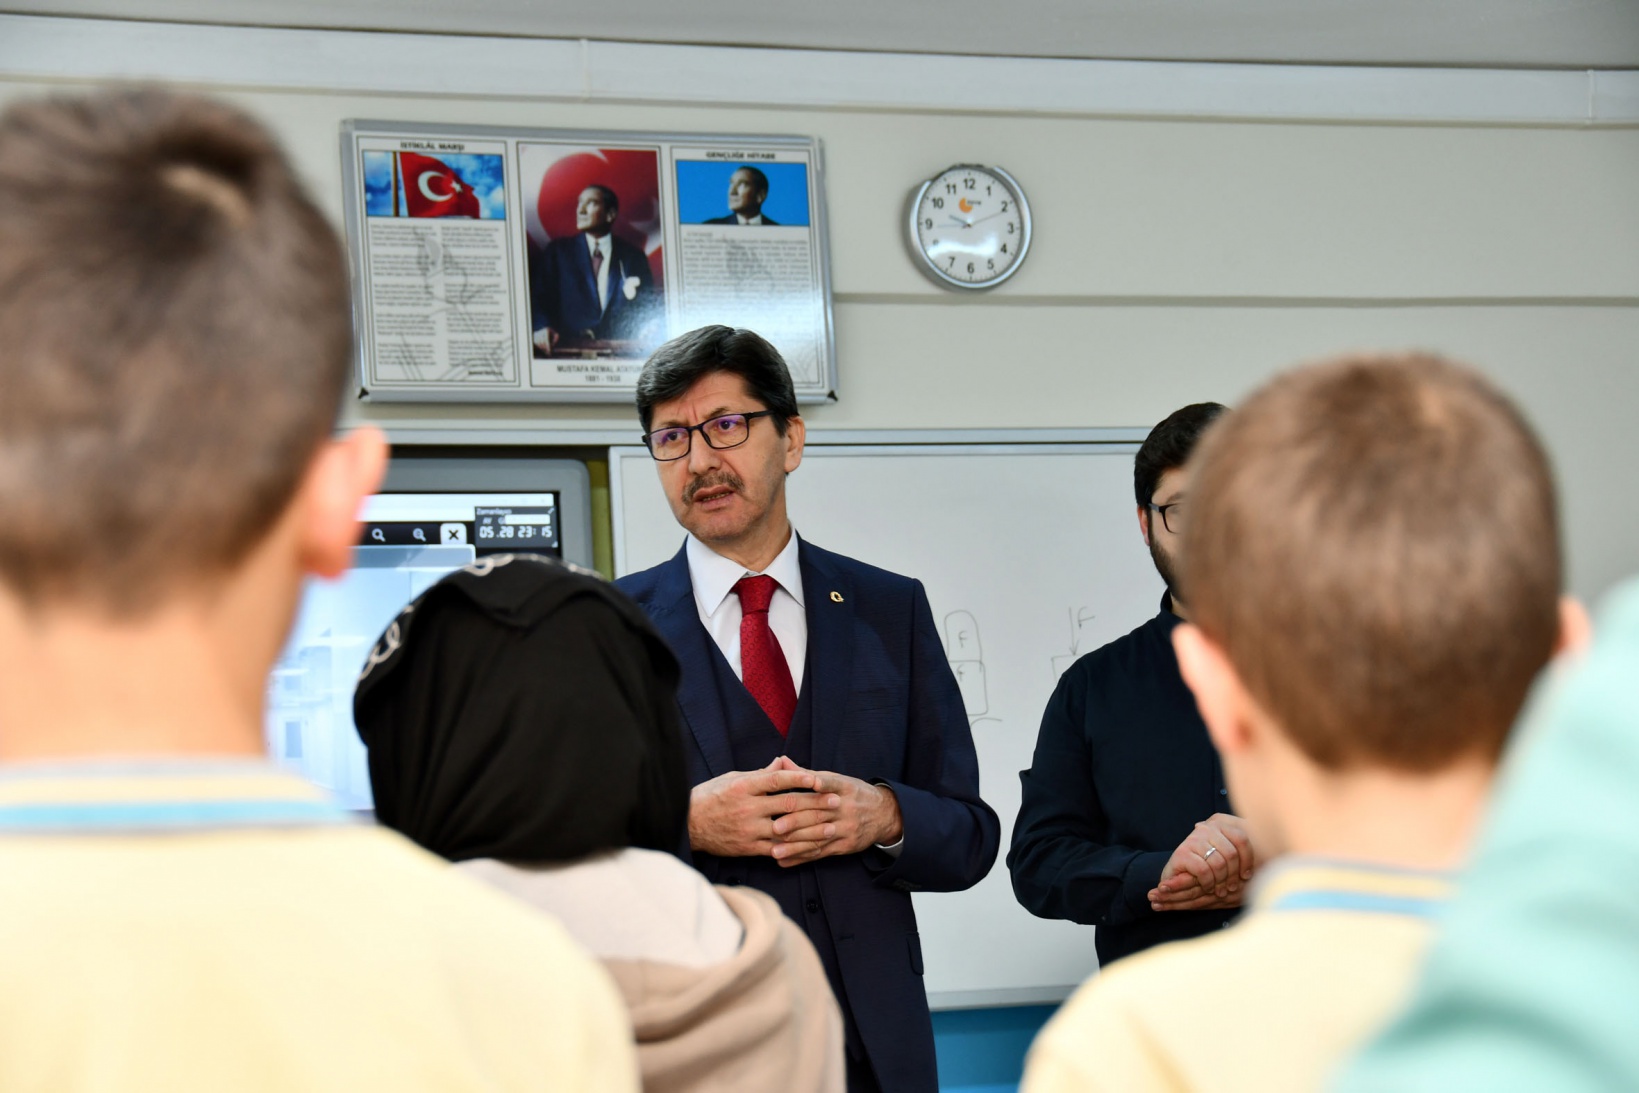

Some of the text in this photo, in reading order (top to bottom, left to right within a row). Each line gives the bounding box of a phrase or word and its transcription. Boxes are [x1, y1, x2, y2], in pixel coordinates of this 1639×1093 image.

[946, 184, 956, 194] 11
[964, 178, 975, 190] 12
[986, 185, 991, 196] 1
[932, 197, 944, 209] 10
[1001, 201, 1008, 213] 2
[925, 219, 933, 230] 9
[1007, 222, 1014, 234] 3
[1000, 242, 1007, 254] 4
[948, 256, 955, 267] 7
[987, 258, 994, 270] 5
[967, 262, 974, 274] 6
